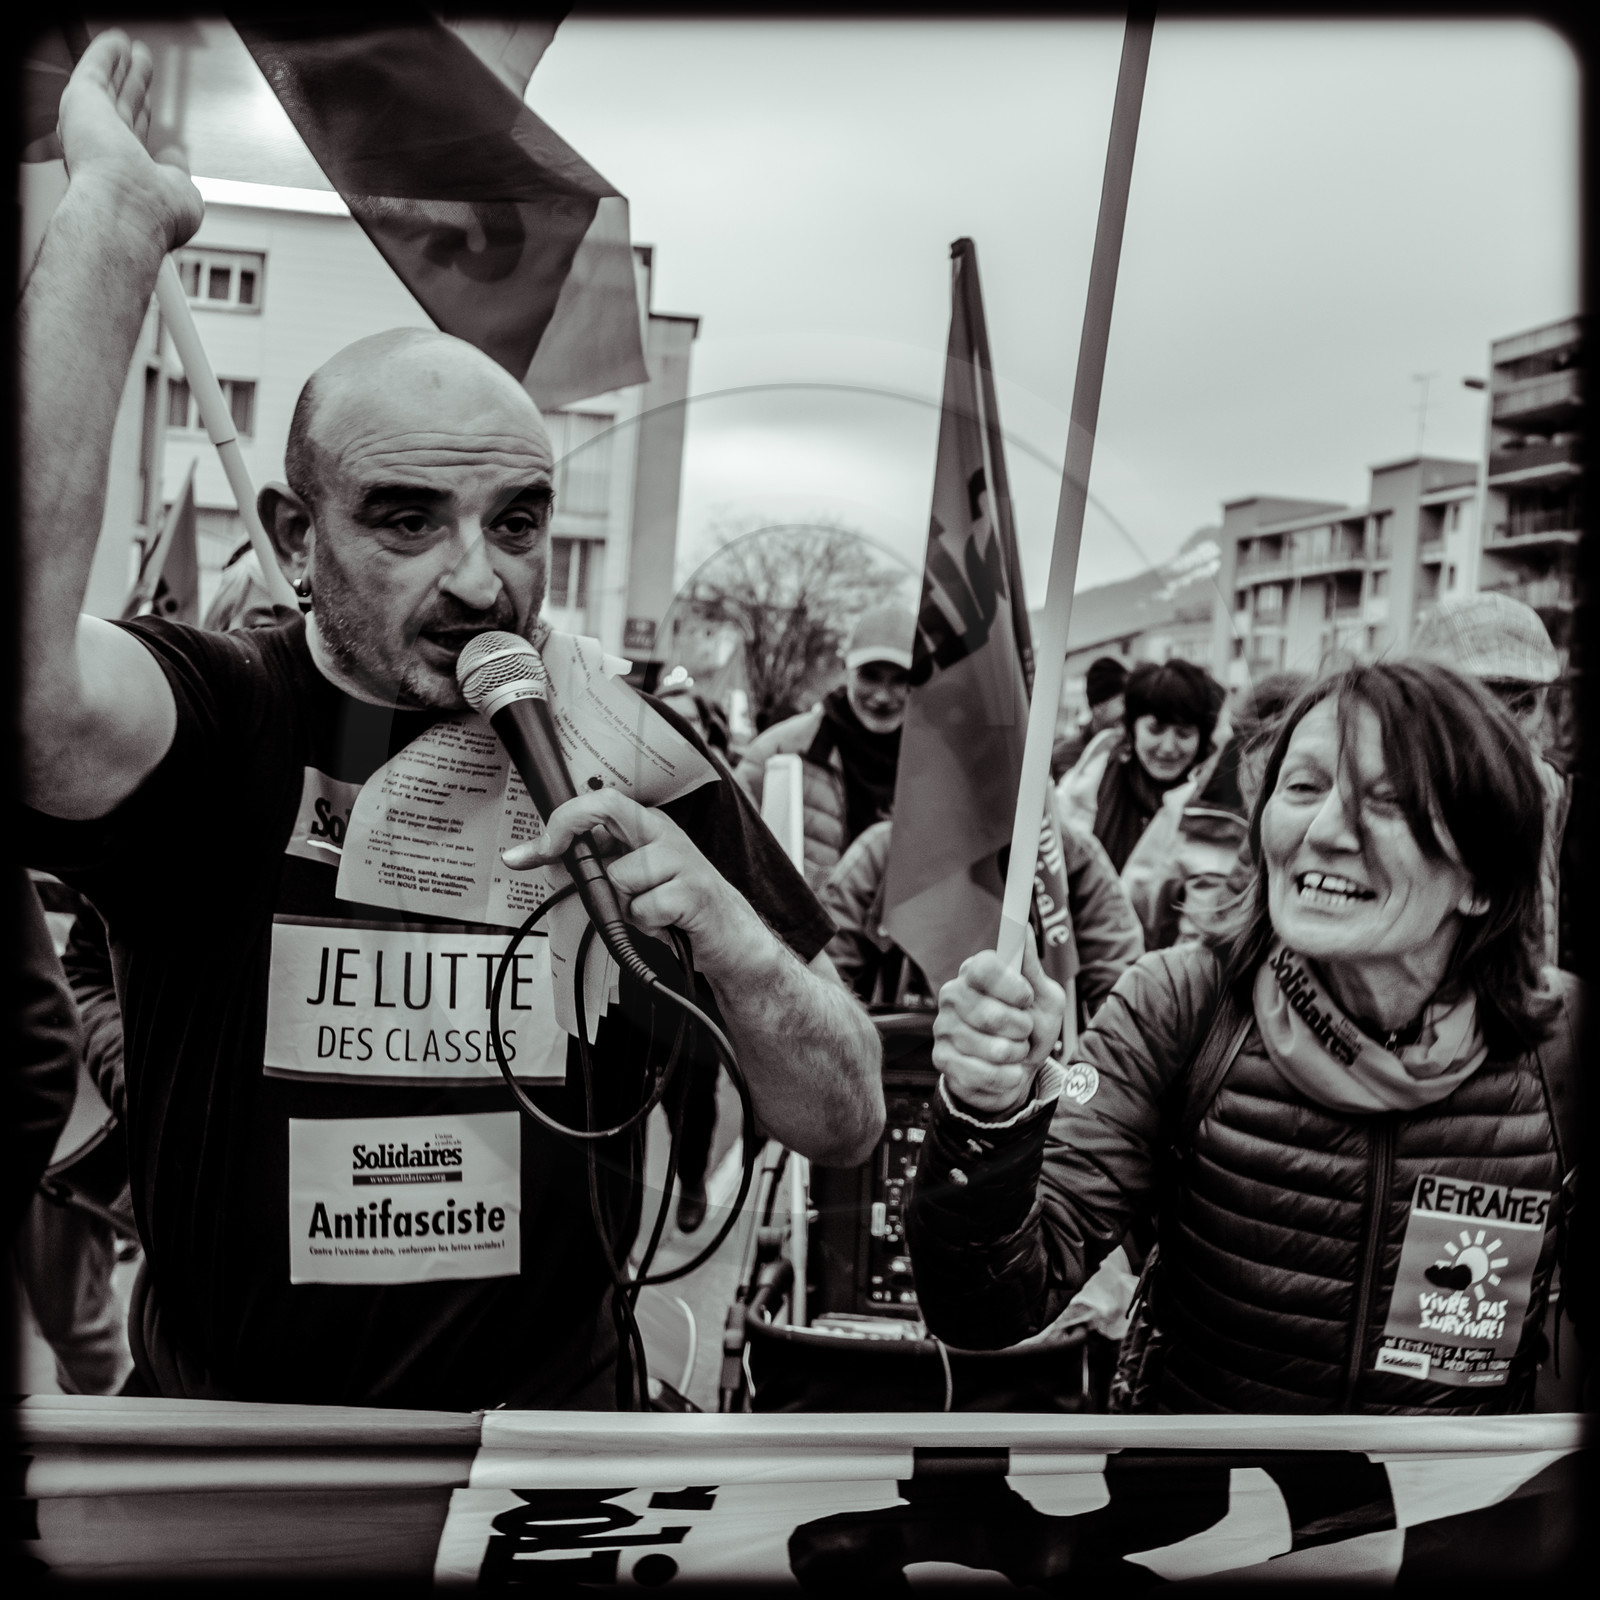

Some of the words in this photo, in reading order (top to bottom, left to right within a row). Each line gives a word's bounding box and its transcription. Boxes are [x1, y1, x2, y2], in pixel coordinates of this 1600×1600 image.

[306, 946, 361, 1008] JE
[373, 949, 535, 1012] LUTTE
[1269, 946, 1357, 1067] Solidaires
[317, 1025, 374, 1062] DES
[385, 1028, 517, 1064] CLASSES
[352, 1141, 463, 1171] Solidaires
[369, 1172, 447, 1184] www.solidaires.org
[308, 1198, 507, 1240] Antifasciste
[1416, 1177, 1551, 1226] RETRAITES
[1477, 1299, 1509, 1320] PAS
